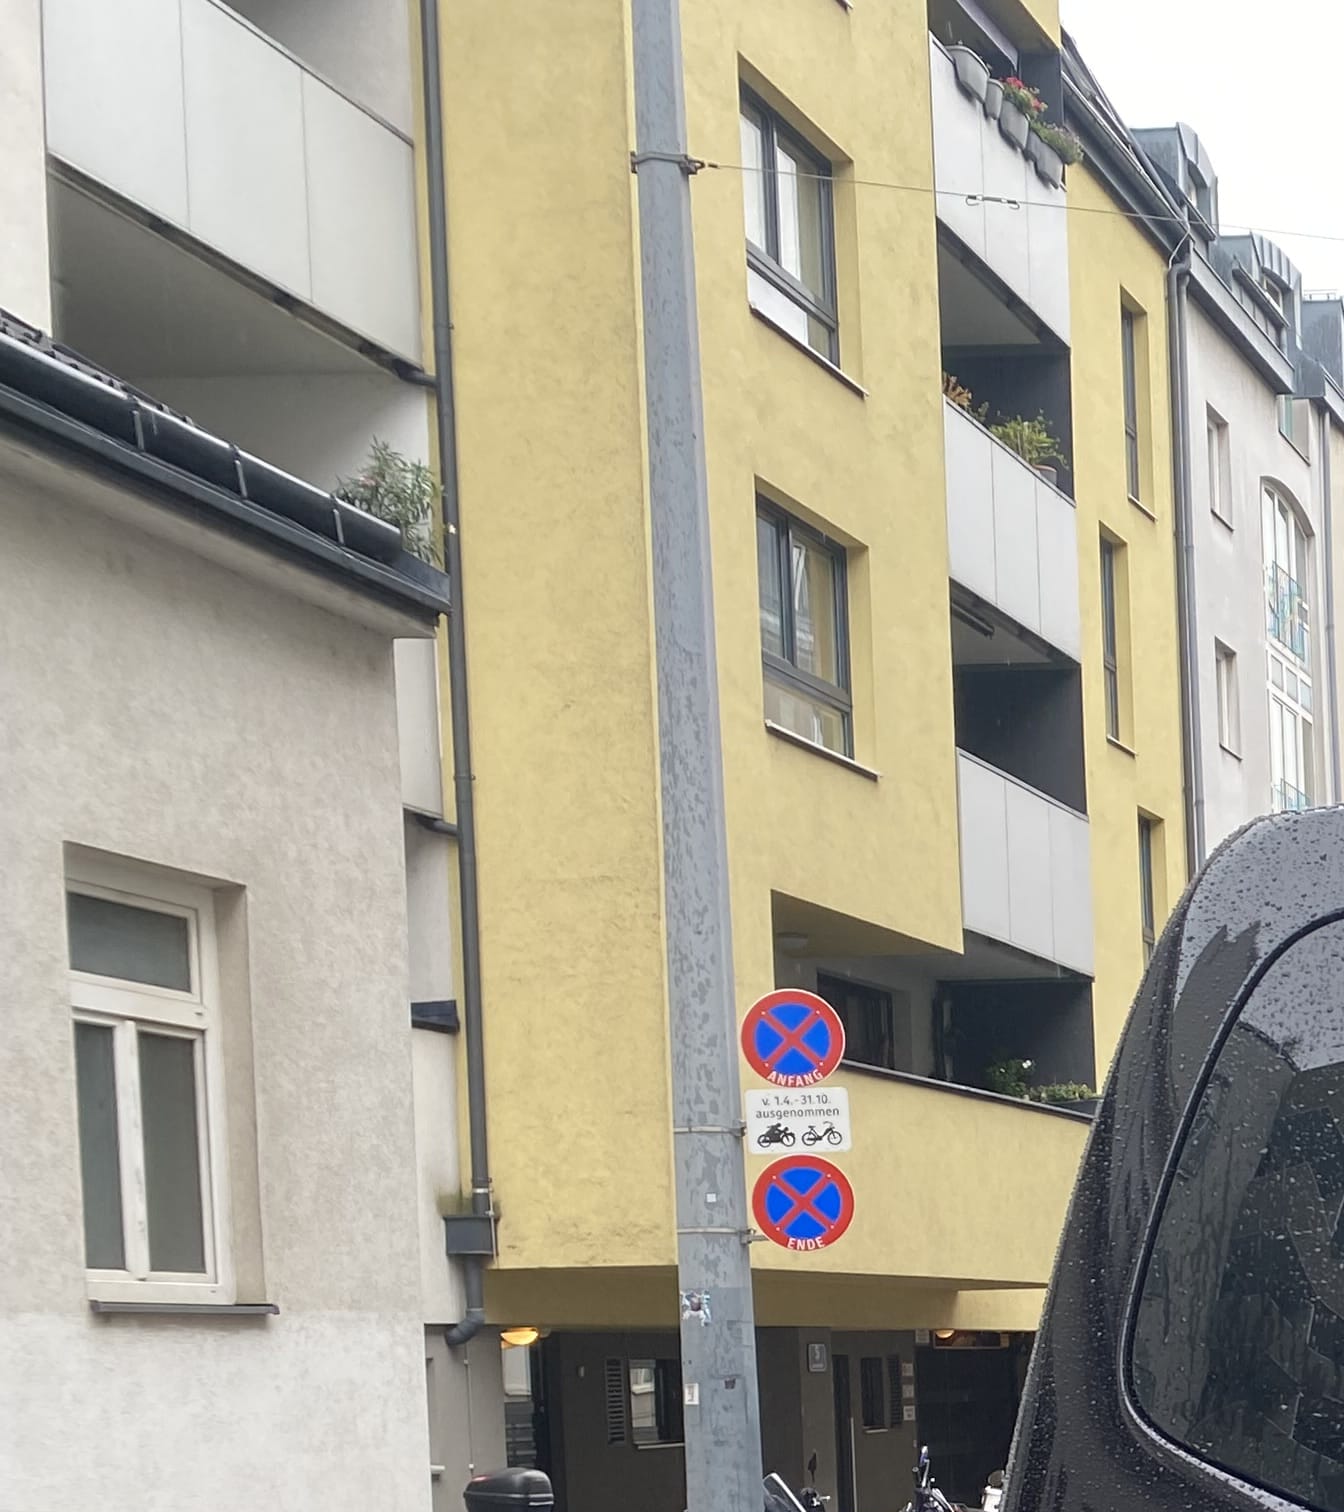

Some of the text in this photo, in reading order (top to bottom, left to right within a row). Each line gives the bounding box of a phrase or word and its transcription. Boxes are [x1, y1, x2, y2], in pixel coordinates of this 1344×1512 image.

[767, 1069, 823, 1087] ANFANG
[756, 1108, 839, 1120] ausgenommen
[787, 1236, 825, 1250] ENDE
